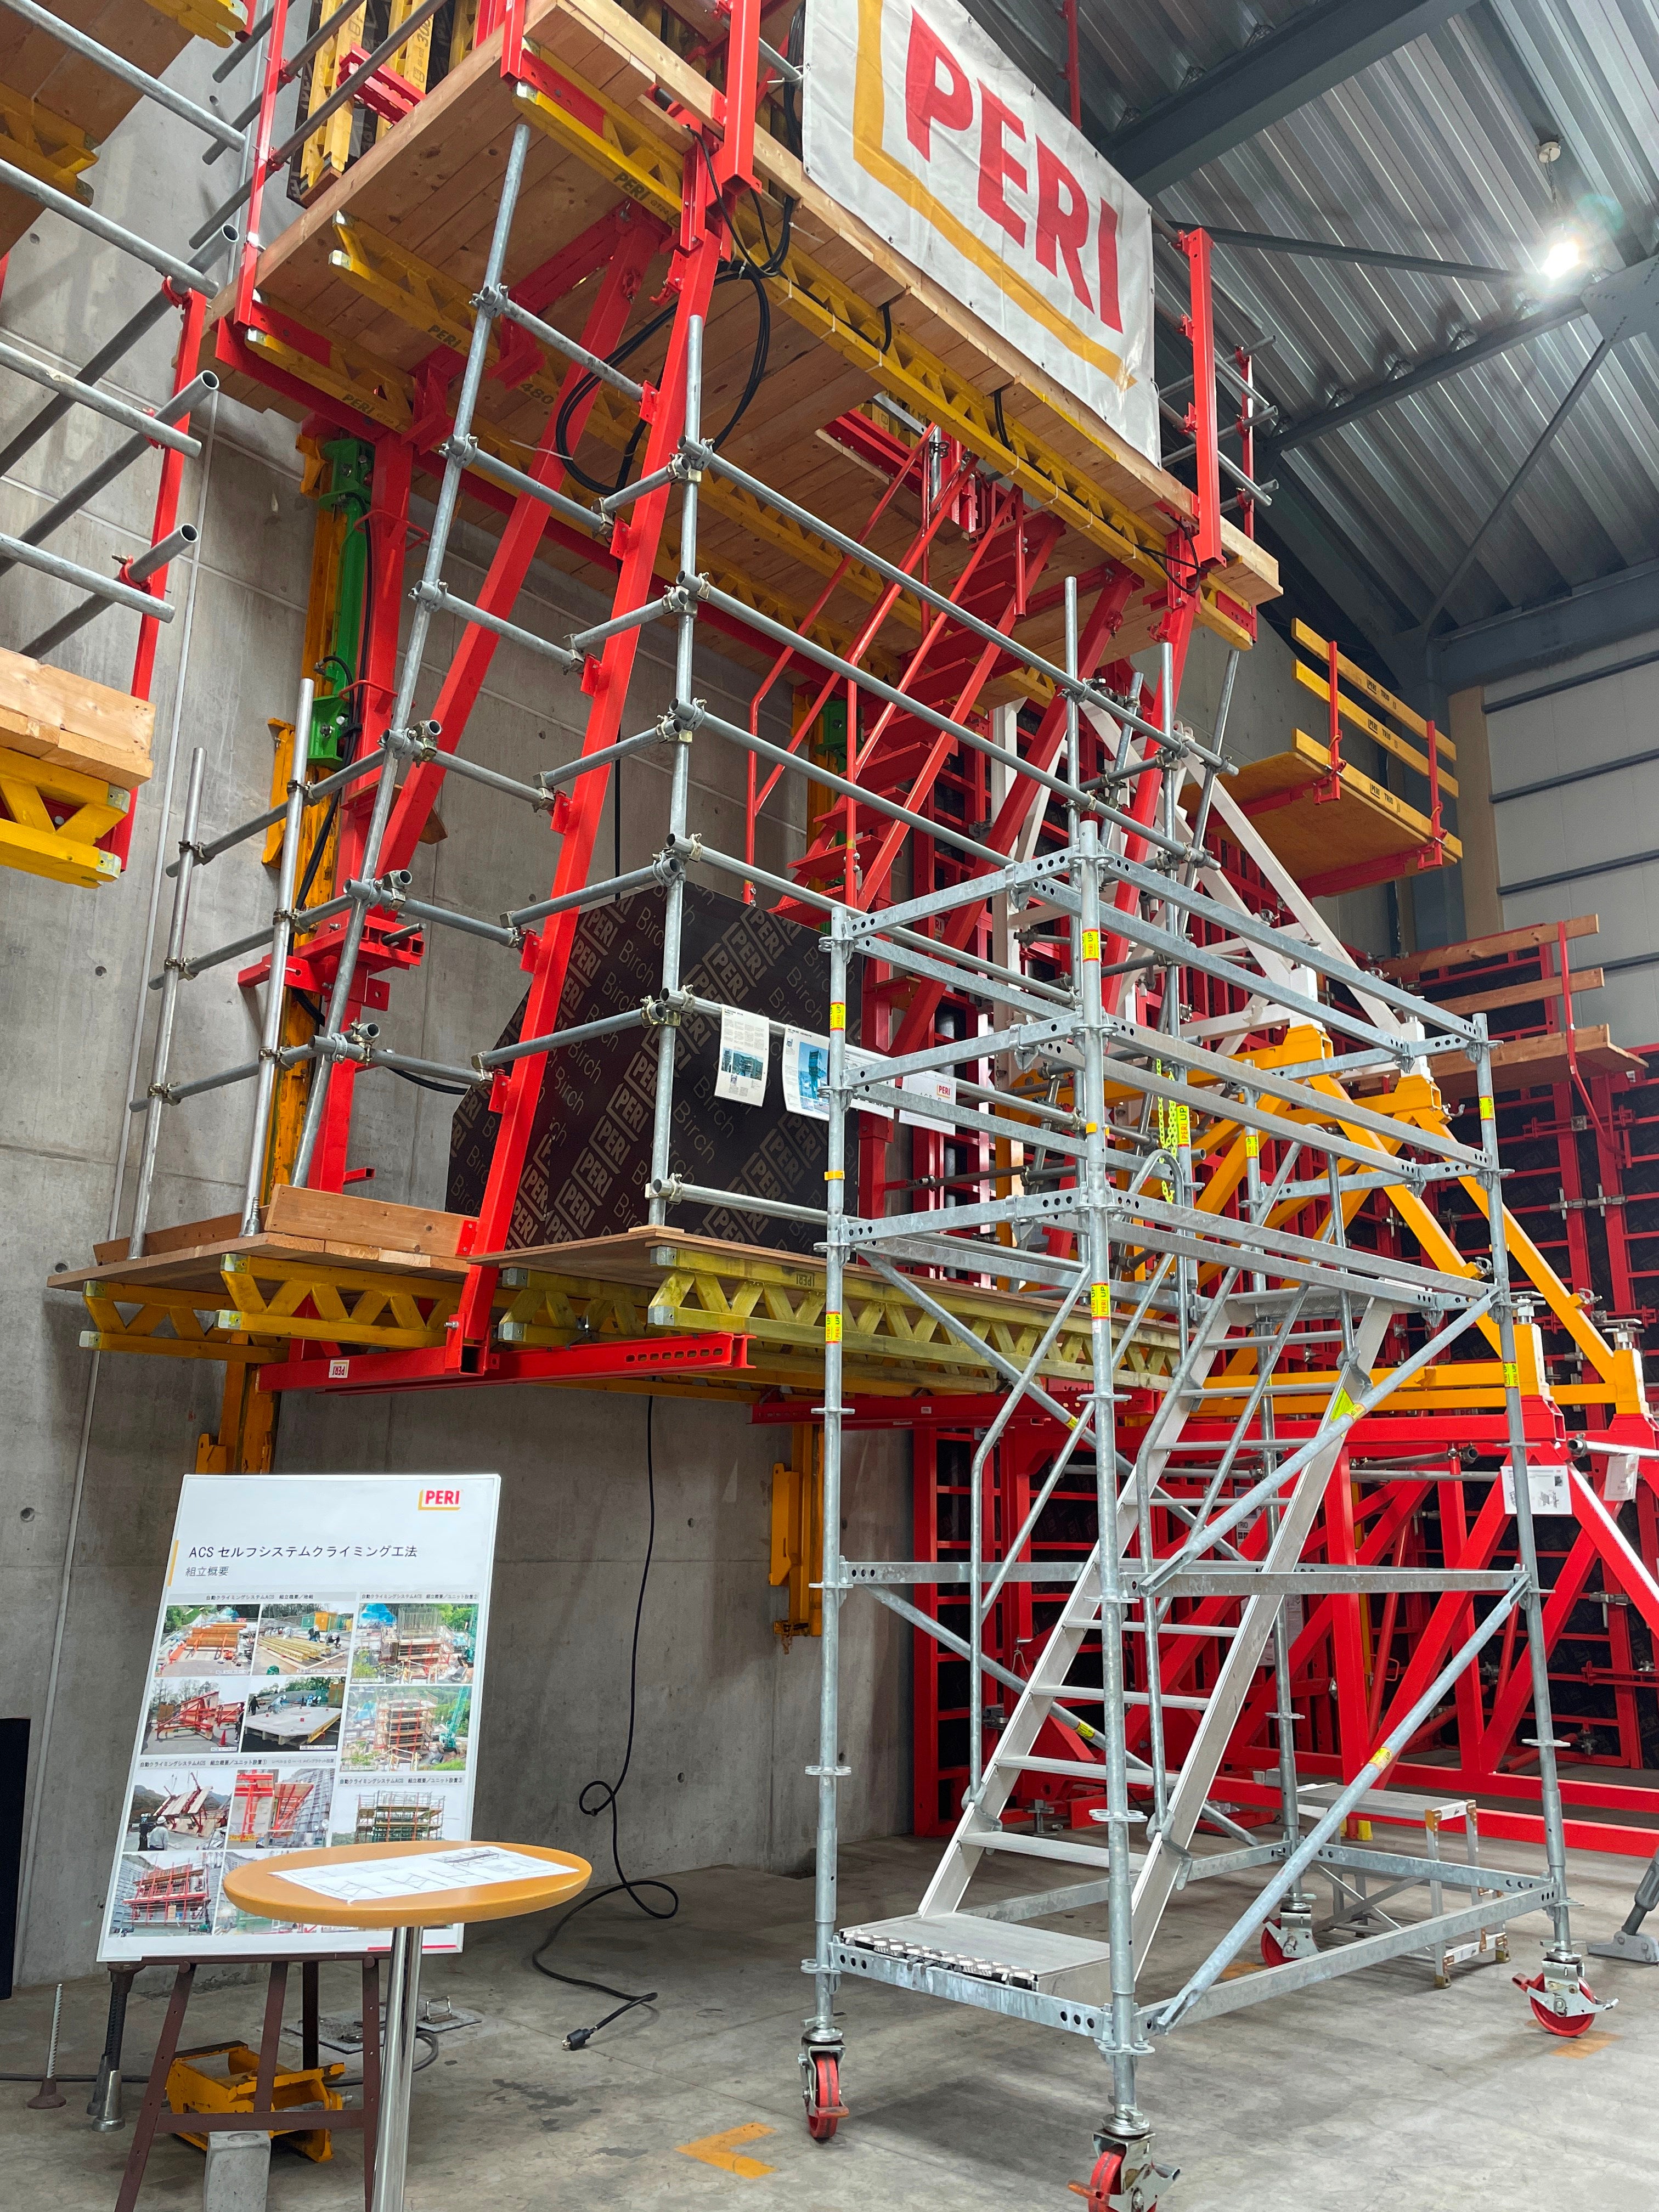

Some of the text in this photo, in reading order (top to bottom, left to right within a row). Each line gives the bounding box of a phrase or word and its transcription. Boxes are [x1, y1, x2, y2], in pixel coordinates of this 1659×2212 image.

[613, 171, 651, 201] PERI
[905, 4, 1123, 334] PERI
[427, 324, 461, 348] PERI
[342, 393, 376, 414] PERI
[521, 383, 555, 404] 480
[1371, 783, 1393, 805] PERI TRIO
[587, 908, 618, 947] PERI
[636, 906, 665, 950] Birc
[749, 908, 785, 960] PERI
[1088, 932, 1093, 942] UP
[571, 939, 602, 980] PERI
[618, 939, 654, 988] Birch
[731, 930, 768, 980] PERI
[803, 945, 831, 992] Birc
[562, 979, 585, 1011] ERI
[712, 951, 749, 1002] PERI
[786, 965, 823, 1026] Birch
[836, 1005, 841, 1013] UP
[614, 1087, 650, 1133] PERI
[693, 1075, 735, 1139] Birch
[939, 1085, 951, 1096] PERI
[673, 1099, 715, 1164] Birch
[1180, 1108, 1187, 1121] UP
[598, 1119, 631, 1166] PERI
[787, 1115, 822, 1162] PERI
[579, 1152, 613, 1198] PERI
[769, 1135, 805, 1183] PERI
[562, 1183, 596, 1230] PERI
[796, 1273, 812, 1287] PERI
[1101, 1286, 1106, 1297] UP
[835, 1315, 840, 1325] UP
[425, 1489, 461, 1505] PERI
[185, 1566, 230, 1577] 組立概要
[189, 1545, 418, 1559] ACS セルフシステムクライミング工法
